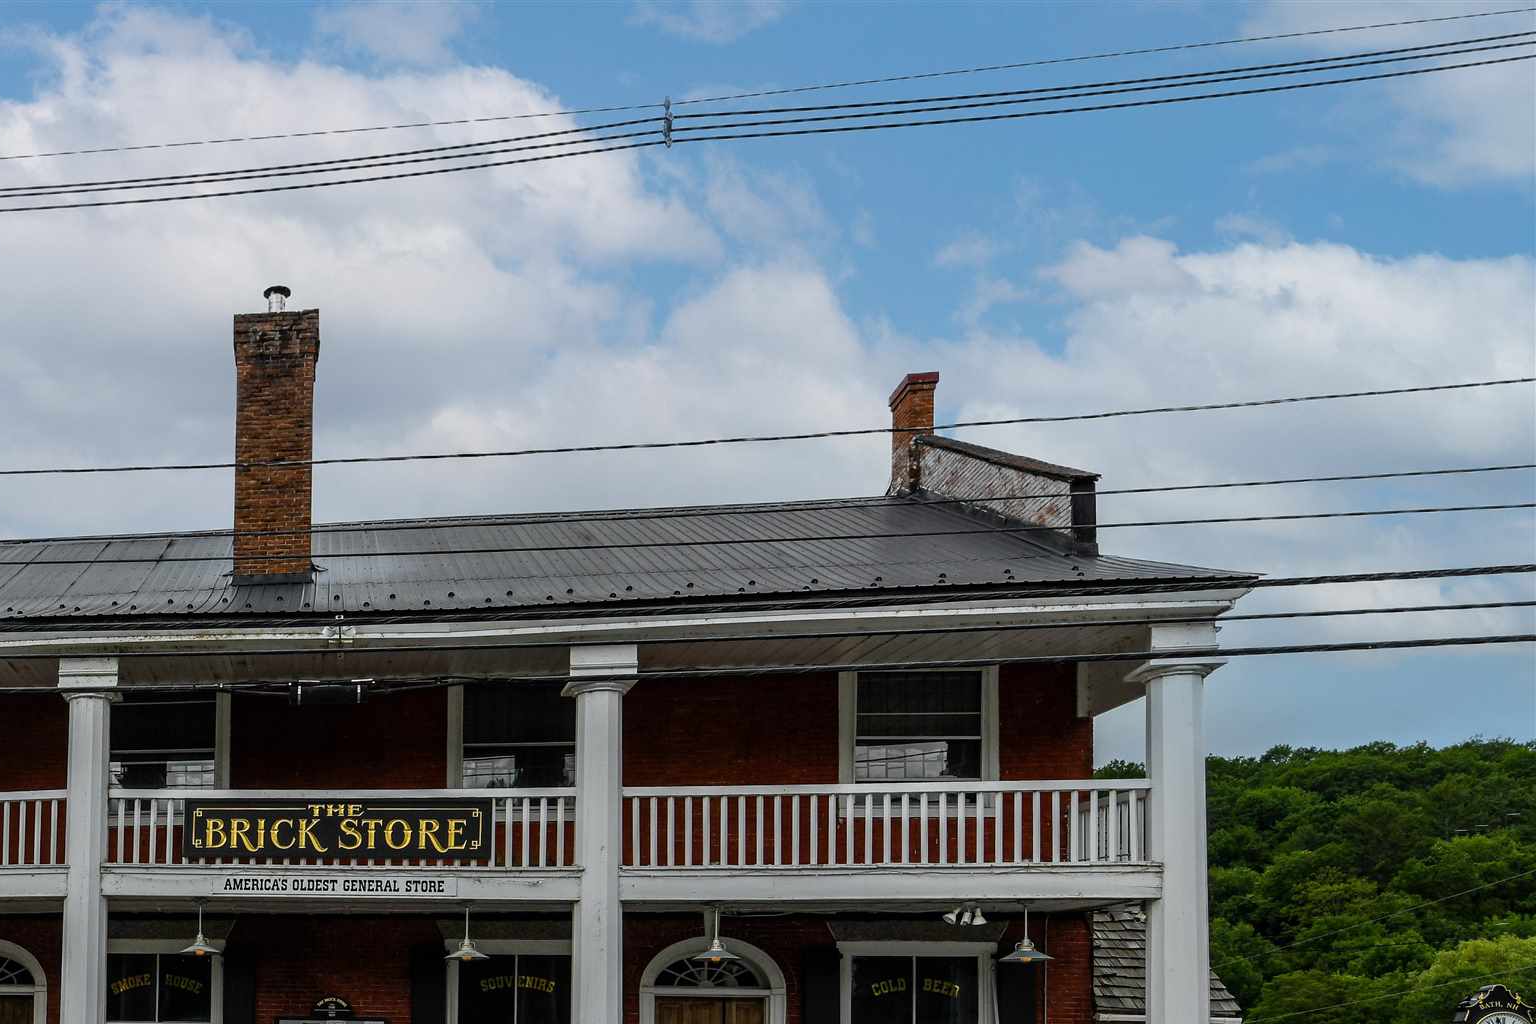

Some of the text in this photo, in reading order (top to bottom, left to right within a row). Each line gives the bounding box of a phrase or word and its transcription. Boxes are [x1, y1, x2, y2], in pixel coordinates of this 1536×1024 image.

[306, 803, 366, 817] THE
[205, 816, 468, 854] BRICK STORE
[223, 877, 445, 893] AMERICA'S OLDEST GENERAL STORE
[111, 973, 203, 994] SMOKE HOUSE
[479, 975, 556, 992] SOUVENIRS
[871, 977, 960, 999] COLD BEER
